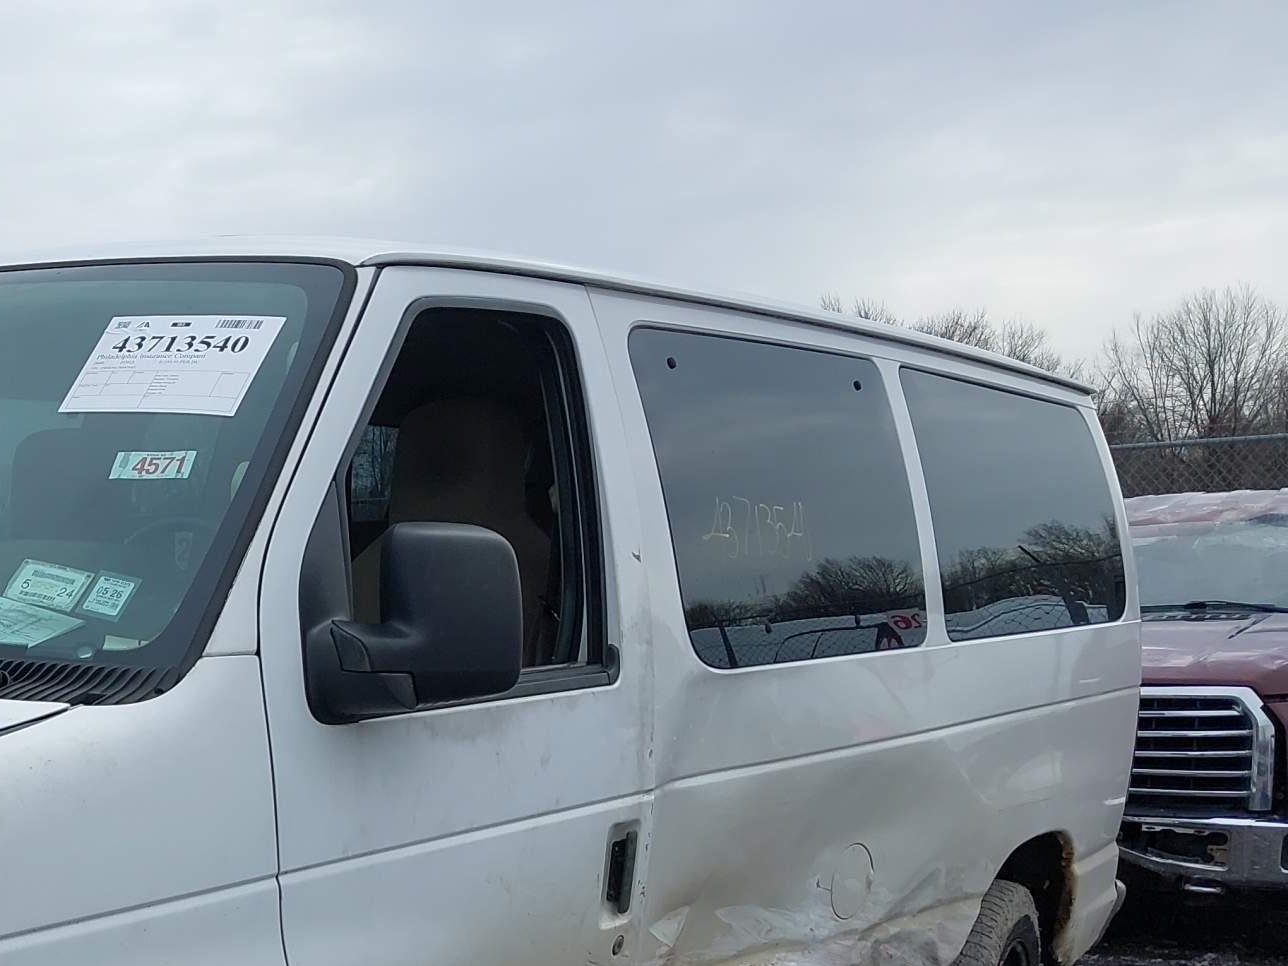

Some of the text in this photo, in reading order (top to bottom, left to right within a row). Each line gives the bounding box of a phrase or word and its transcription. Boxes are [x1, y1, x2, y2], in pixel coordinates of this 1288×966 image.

[112, 335, 250, 354] 43713540
[132, 455, 187, 475] 4571
[20, 578, 32, 590] 5
[56, 587, 76, 600] 24
